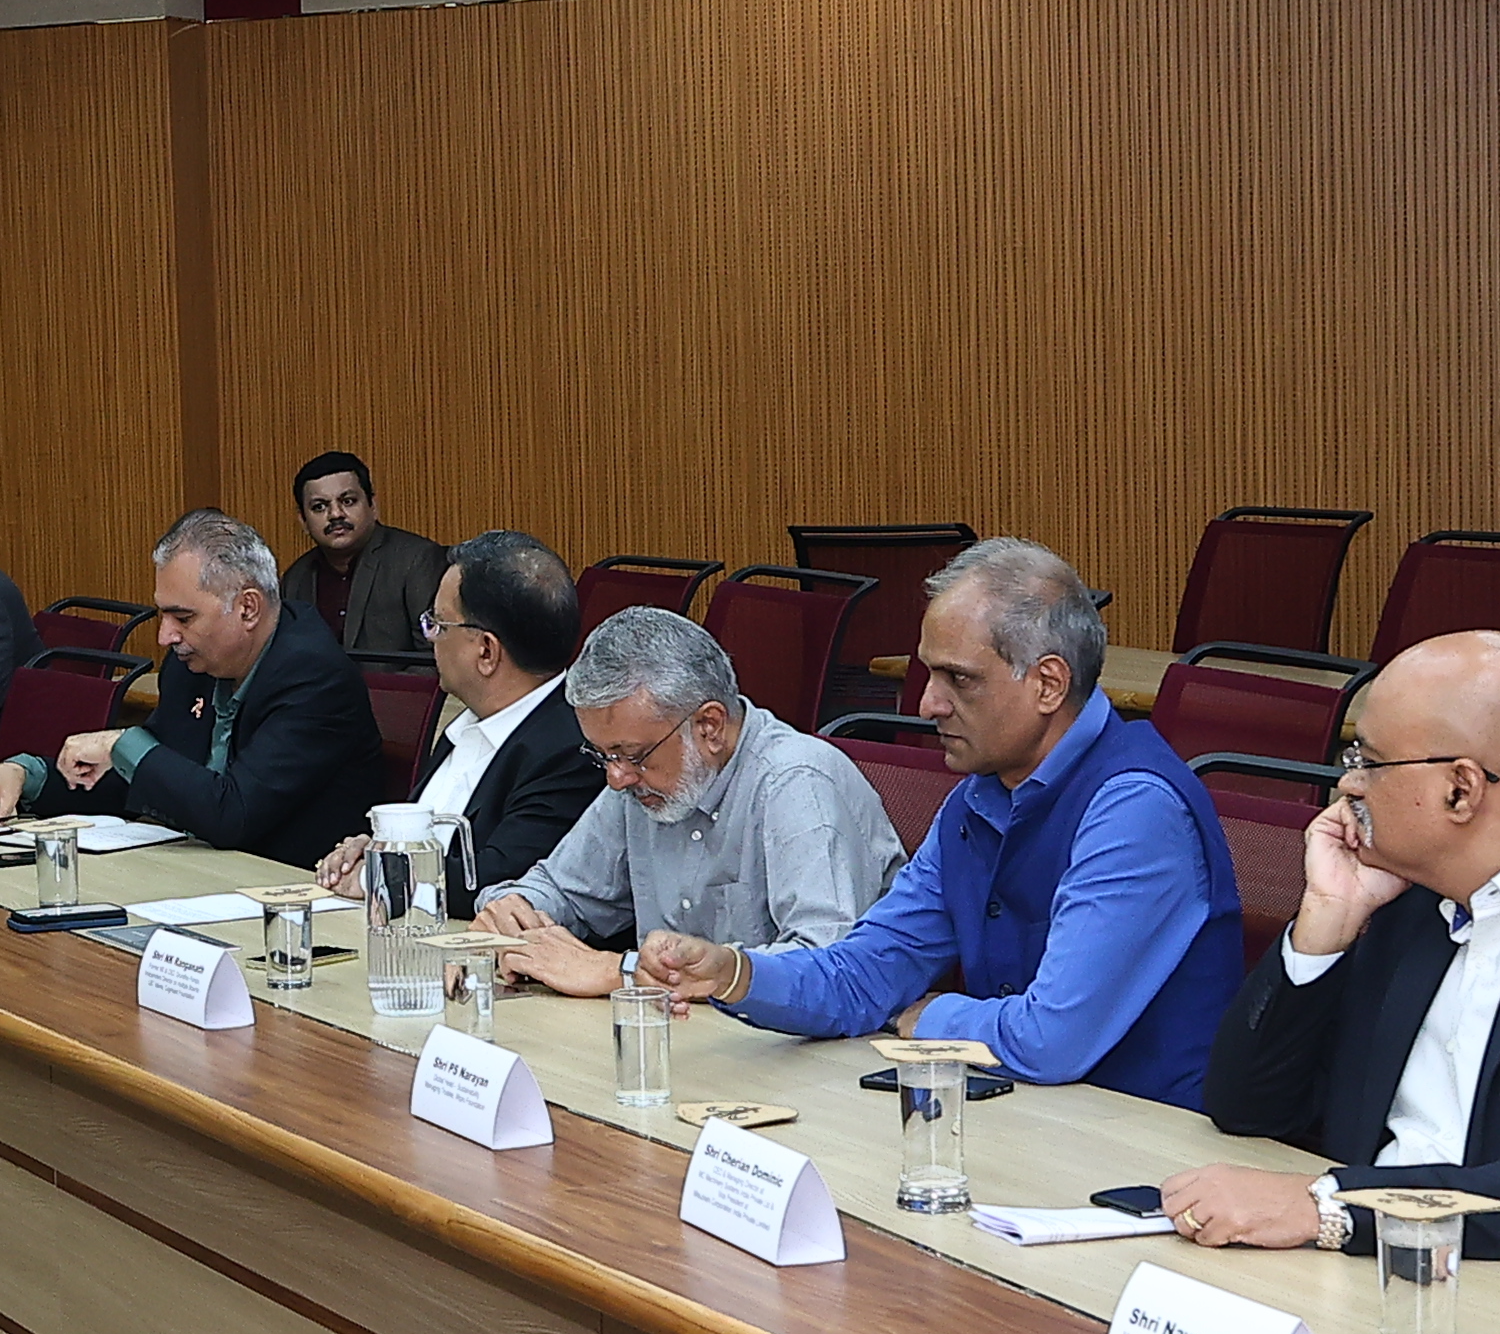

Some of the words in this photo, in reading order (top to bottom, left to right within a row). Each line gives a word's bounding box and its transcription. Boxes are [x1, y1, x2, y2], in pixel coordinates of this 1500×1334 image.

[433, 1056, 448, 1071] Shri
[448, 1063, 459, 1076] PS
[460, 1067, 489, 1088] Narayan
[704, 1144, 720, 1160] Shri
[720, 1150, 751, 1173] Cherian
[751, 1164, 784, 1188] Dominic
[1129, 1307, 1161, 1333] Shri
